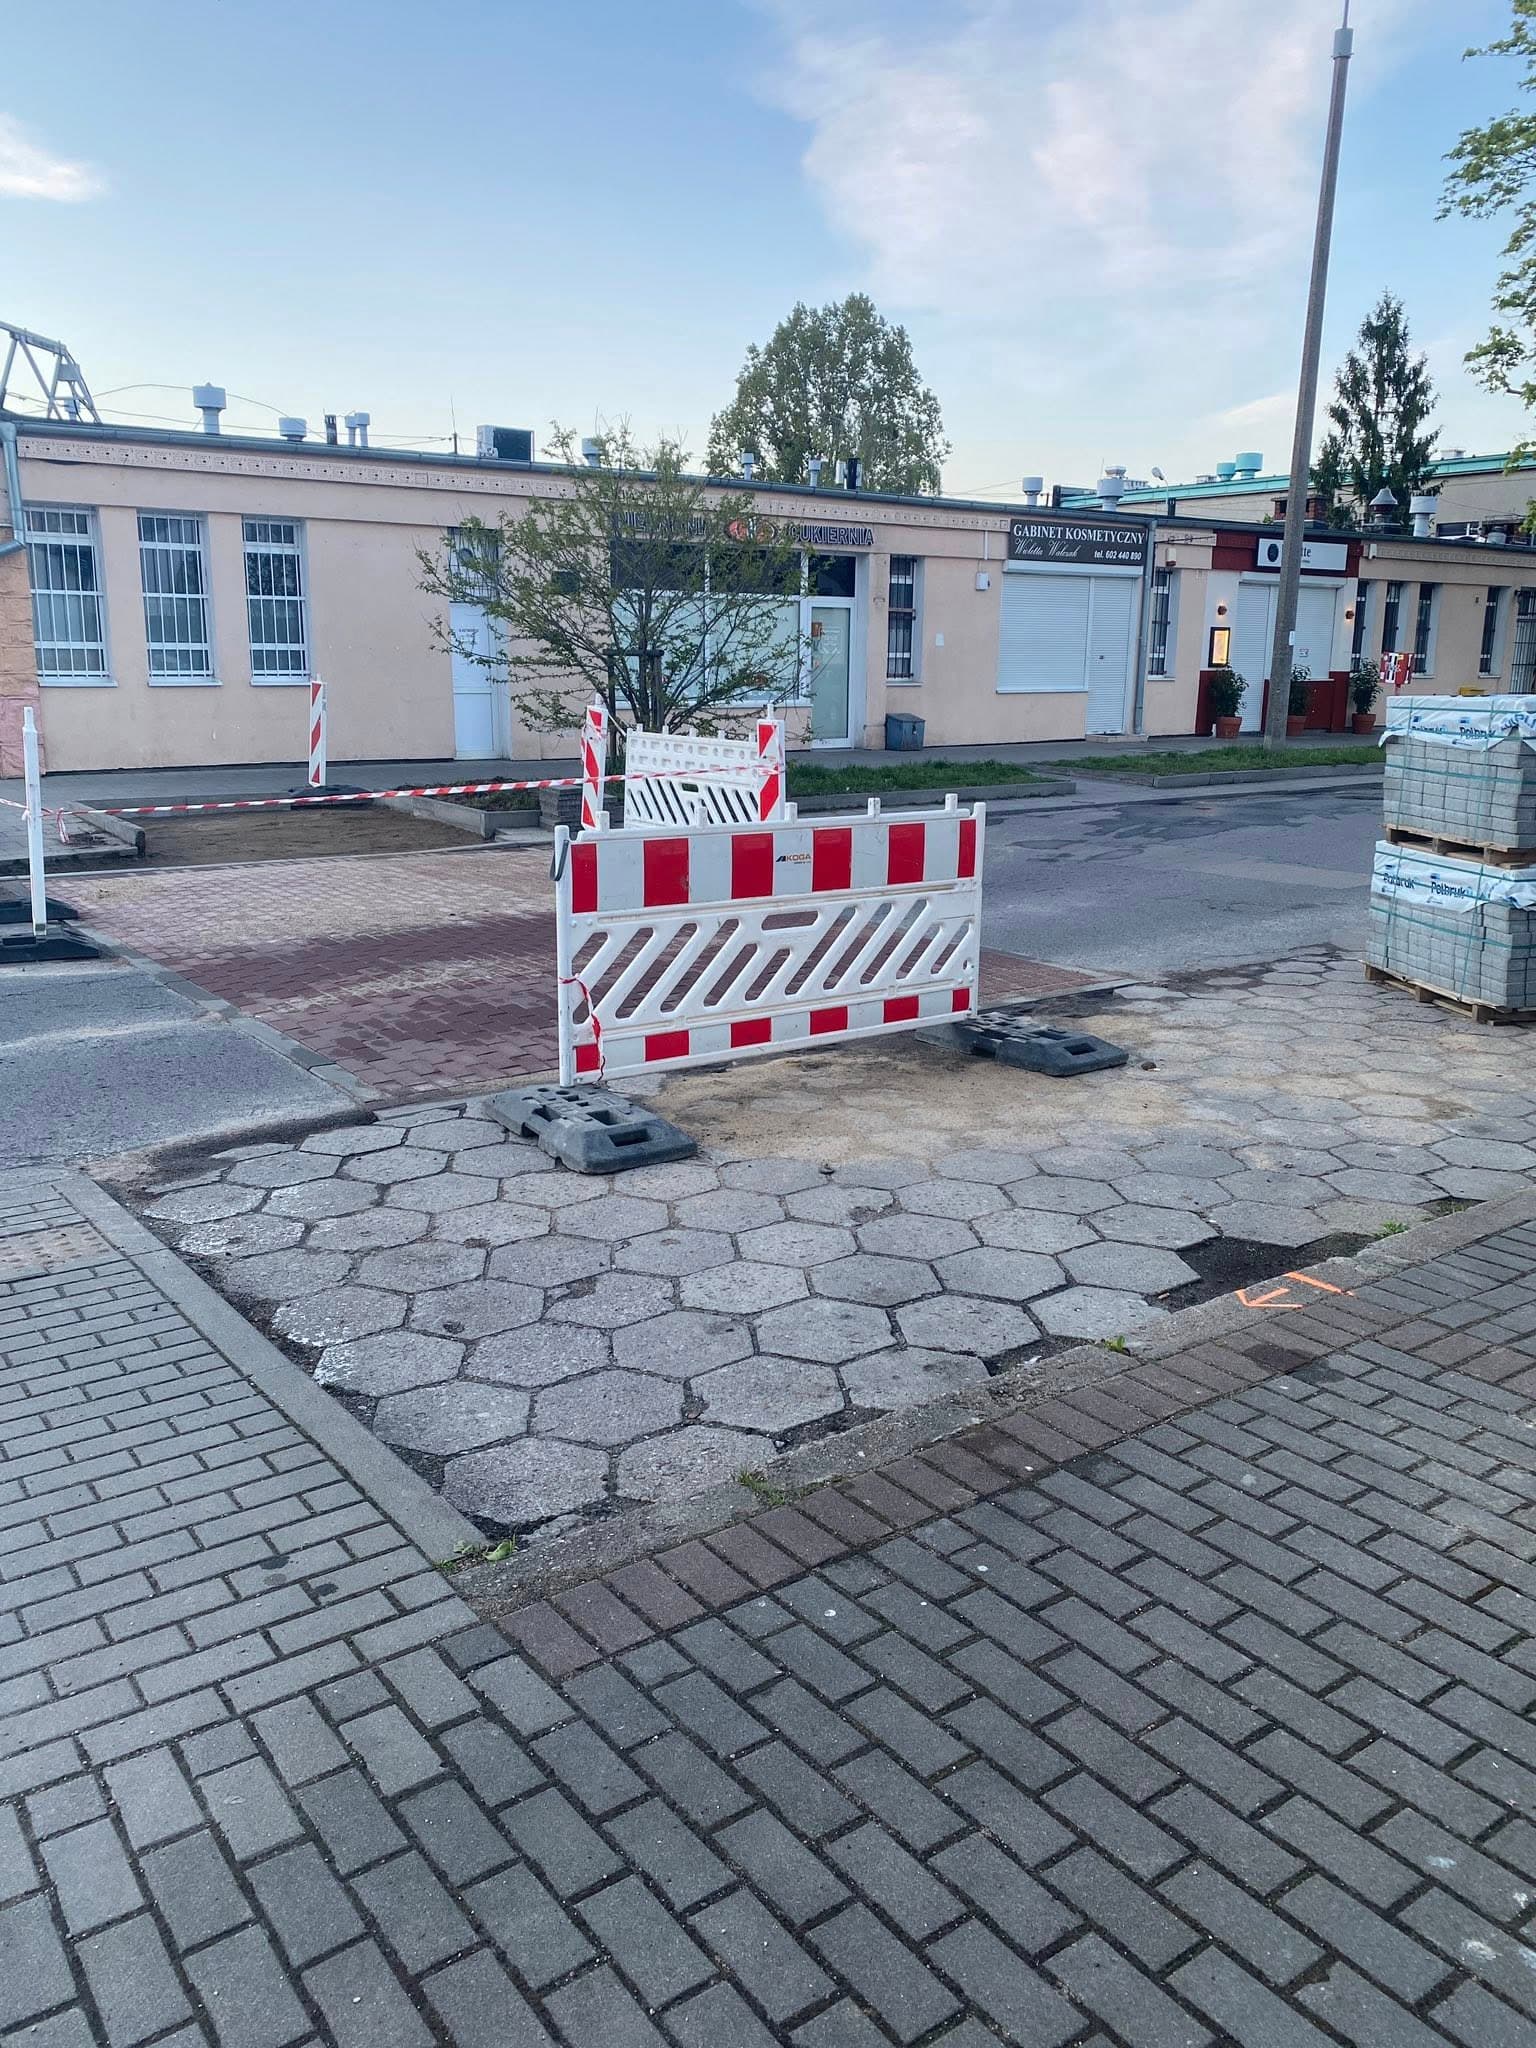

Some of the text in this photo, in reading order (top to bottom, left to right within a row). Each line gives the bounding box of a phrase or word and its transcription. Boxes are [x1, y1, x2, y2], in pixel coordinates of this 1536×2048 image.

[791, 524, 874, 545] CUKIERNIA
[1013, 524, 1145, 545] GABINET KOSMETYCZNY
